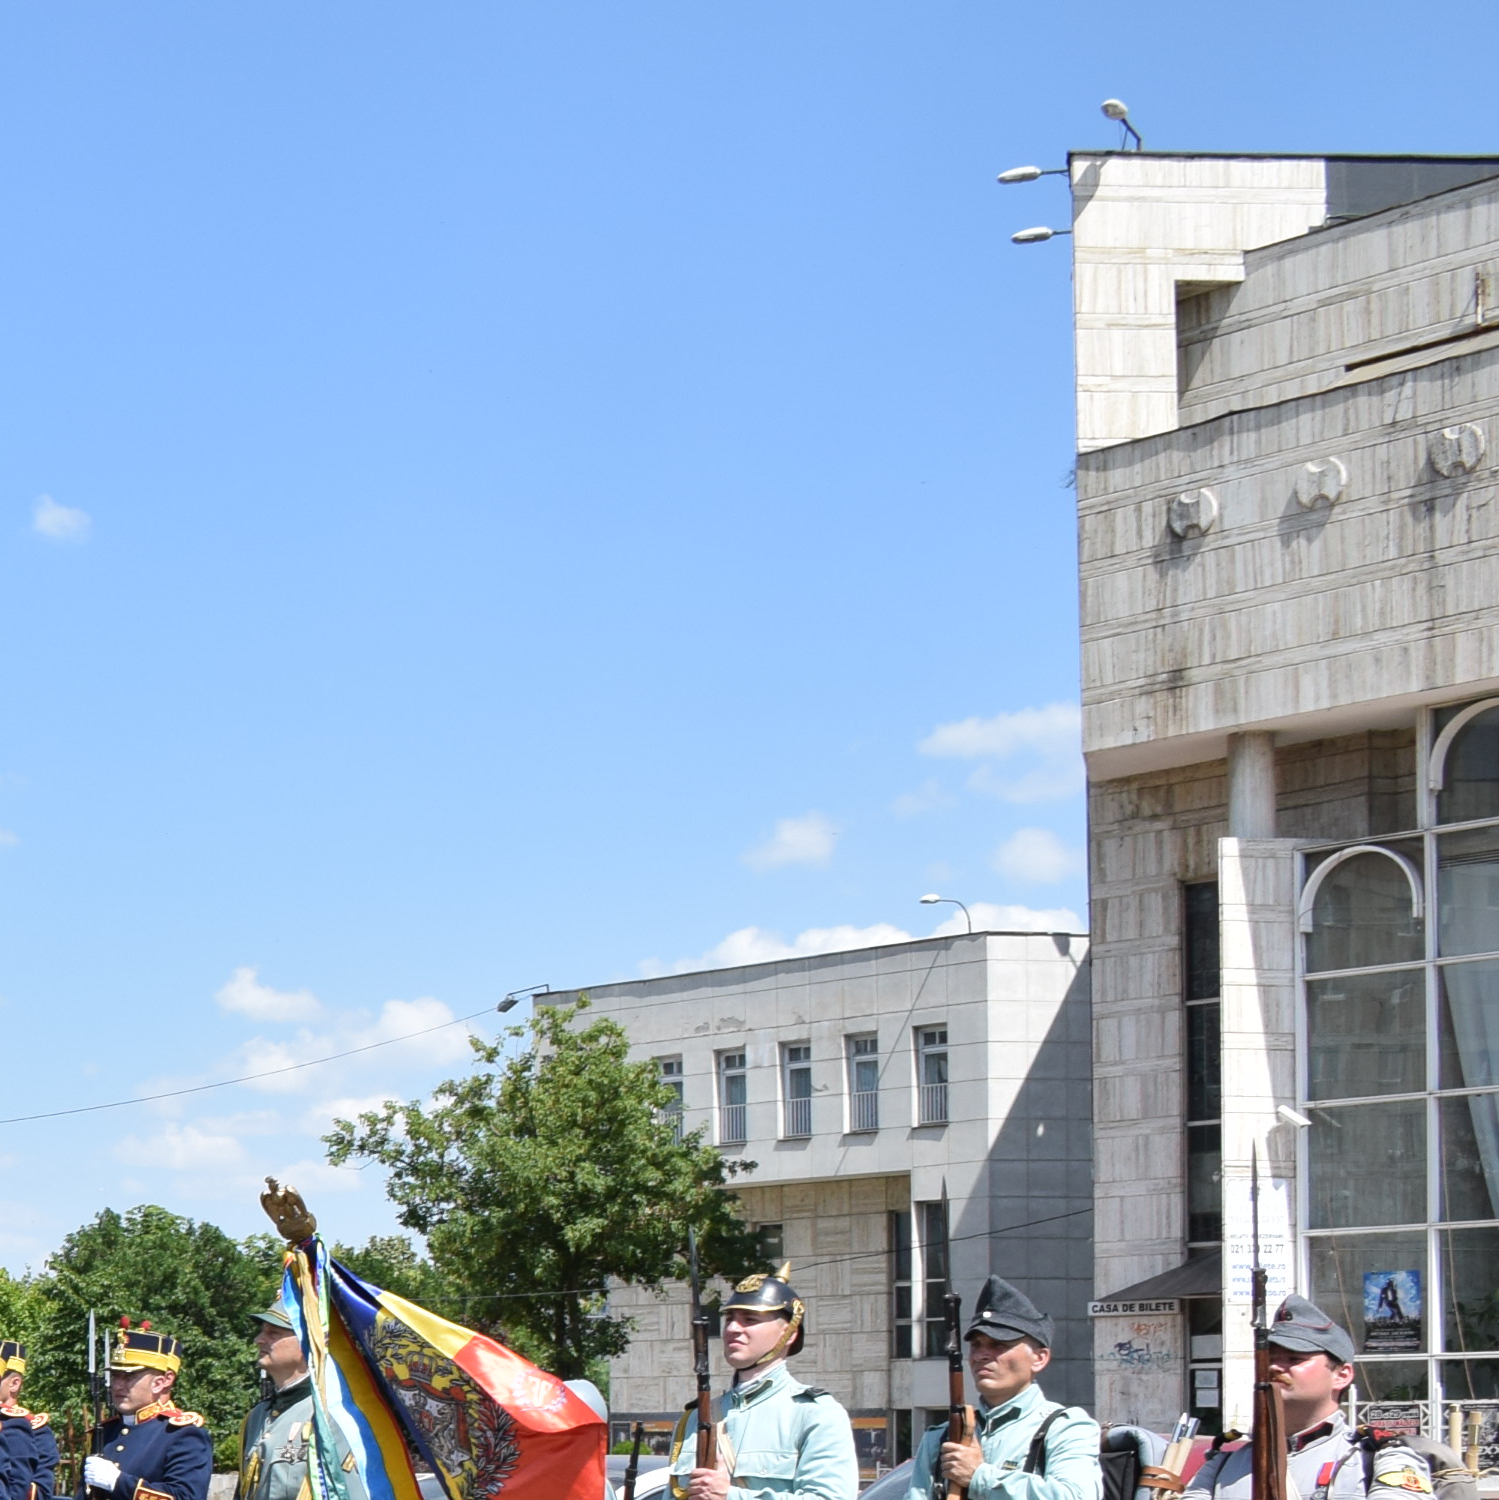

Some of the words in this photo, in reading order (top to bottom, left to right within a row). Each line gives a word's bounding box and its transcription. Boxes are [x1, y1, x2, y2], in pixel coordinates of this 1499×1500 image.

[1091, 1303, 1119, 1314] CASA
[1121, 1302, 1136, 1313] DE
[1138, 1301, 1175, 1312] BILETE
